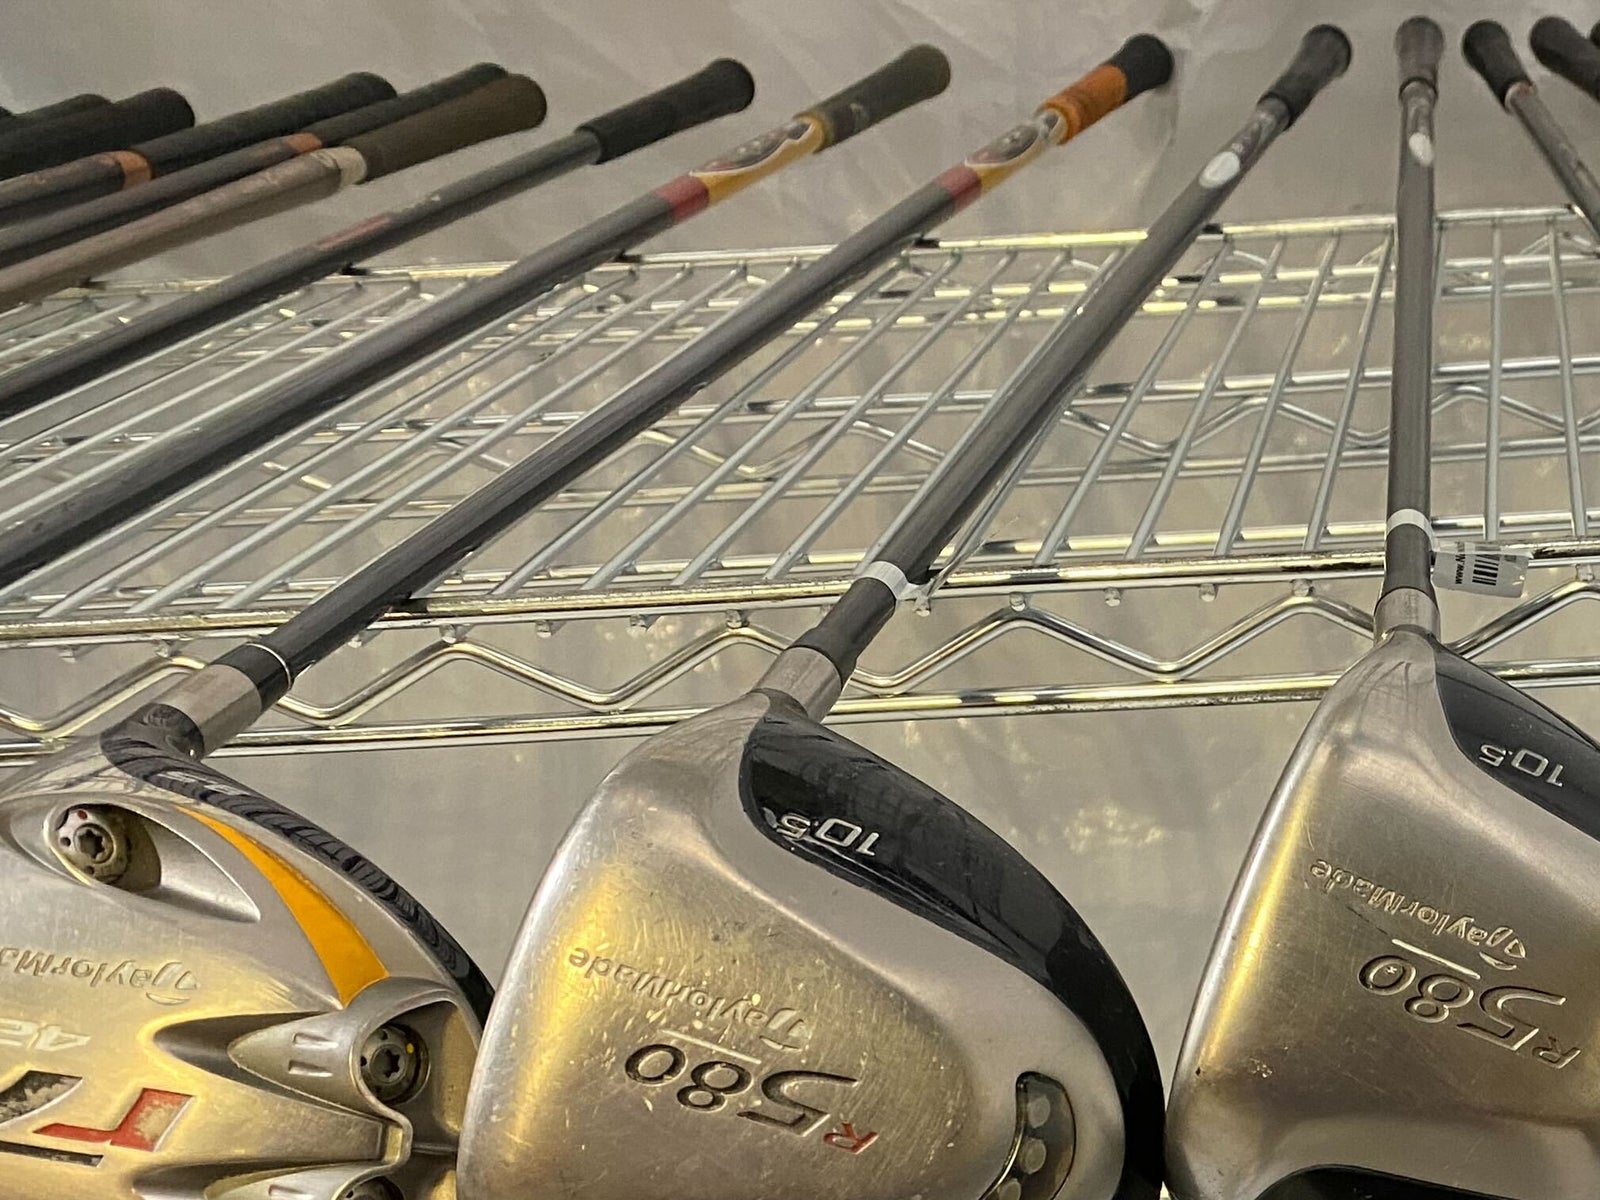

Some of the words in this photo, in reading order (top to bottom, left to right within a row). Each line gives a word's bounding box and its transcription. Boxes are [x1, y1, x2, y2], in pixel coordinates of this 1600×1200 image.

[1479, 744, 1563, 787] 10.5
[776, 812, 880, 856] 10.5
[1310, 858, 1528, 972] TaylorMade
[569, 946, 813, 1050] TaylorMade
